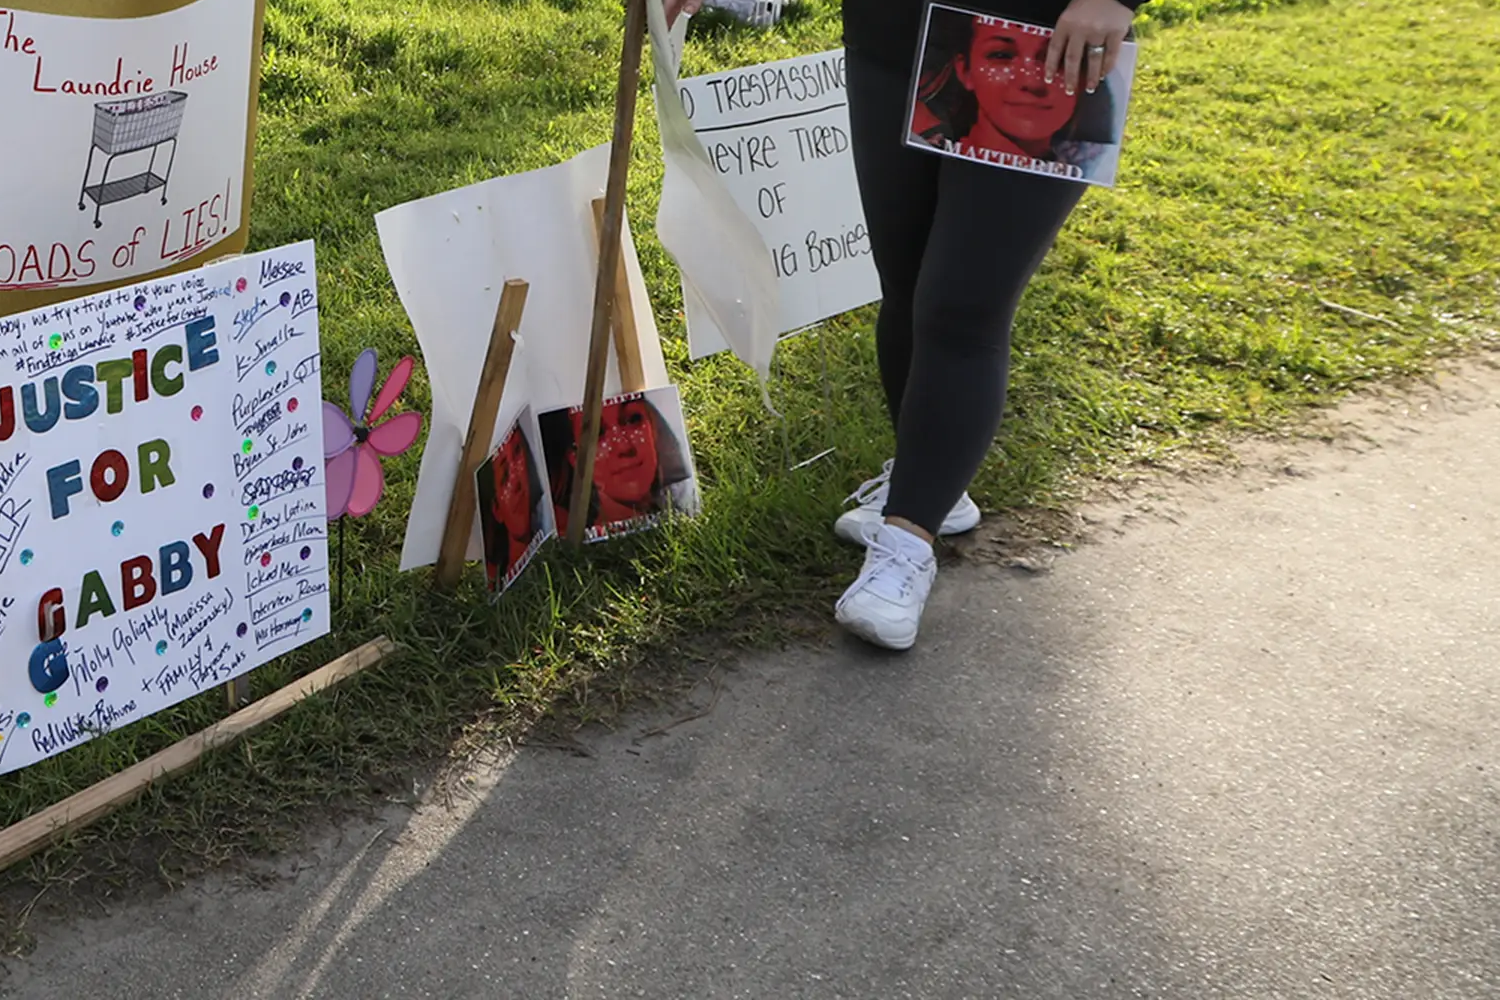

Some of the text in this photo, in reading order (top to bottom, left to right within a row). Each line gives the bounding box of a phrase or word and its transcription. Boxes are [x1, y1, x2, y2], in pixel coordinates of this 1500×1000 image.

[32, 43, 219, 96] Laundrie House
[943, 139, 1084, 180] MATTERED
[112, 227, 146, 269] of
[160, 177, 231, 261] LIES!
[757, 182, 787, 219] OF
[114, 291, 131, 306] to
[151, 284, 177, 300] your
[11, 340, 29, 357] all
[32, 335, 45, 350] of
[45, 438, 176, 521] FOR
[37, 523, 226, 645] GABBY
[155, 645, 202, 696] FAMILY
